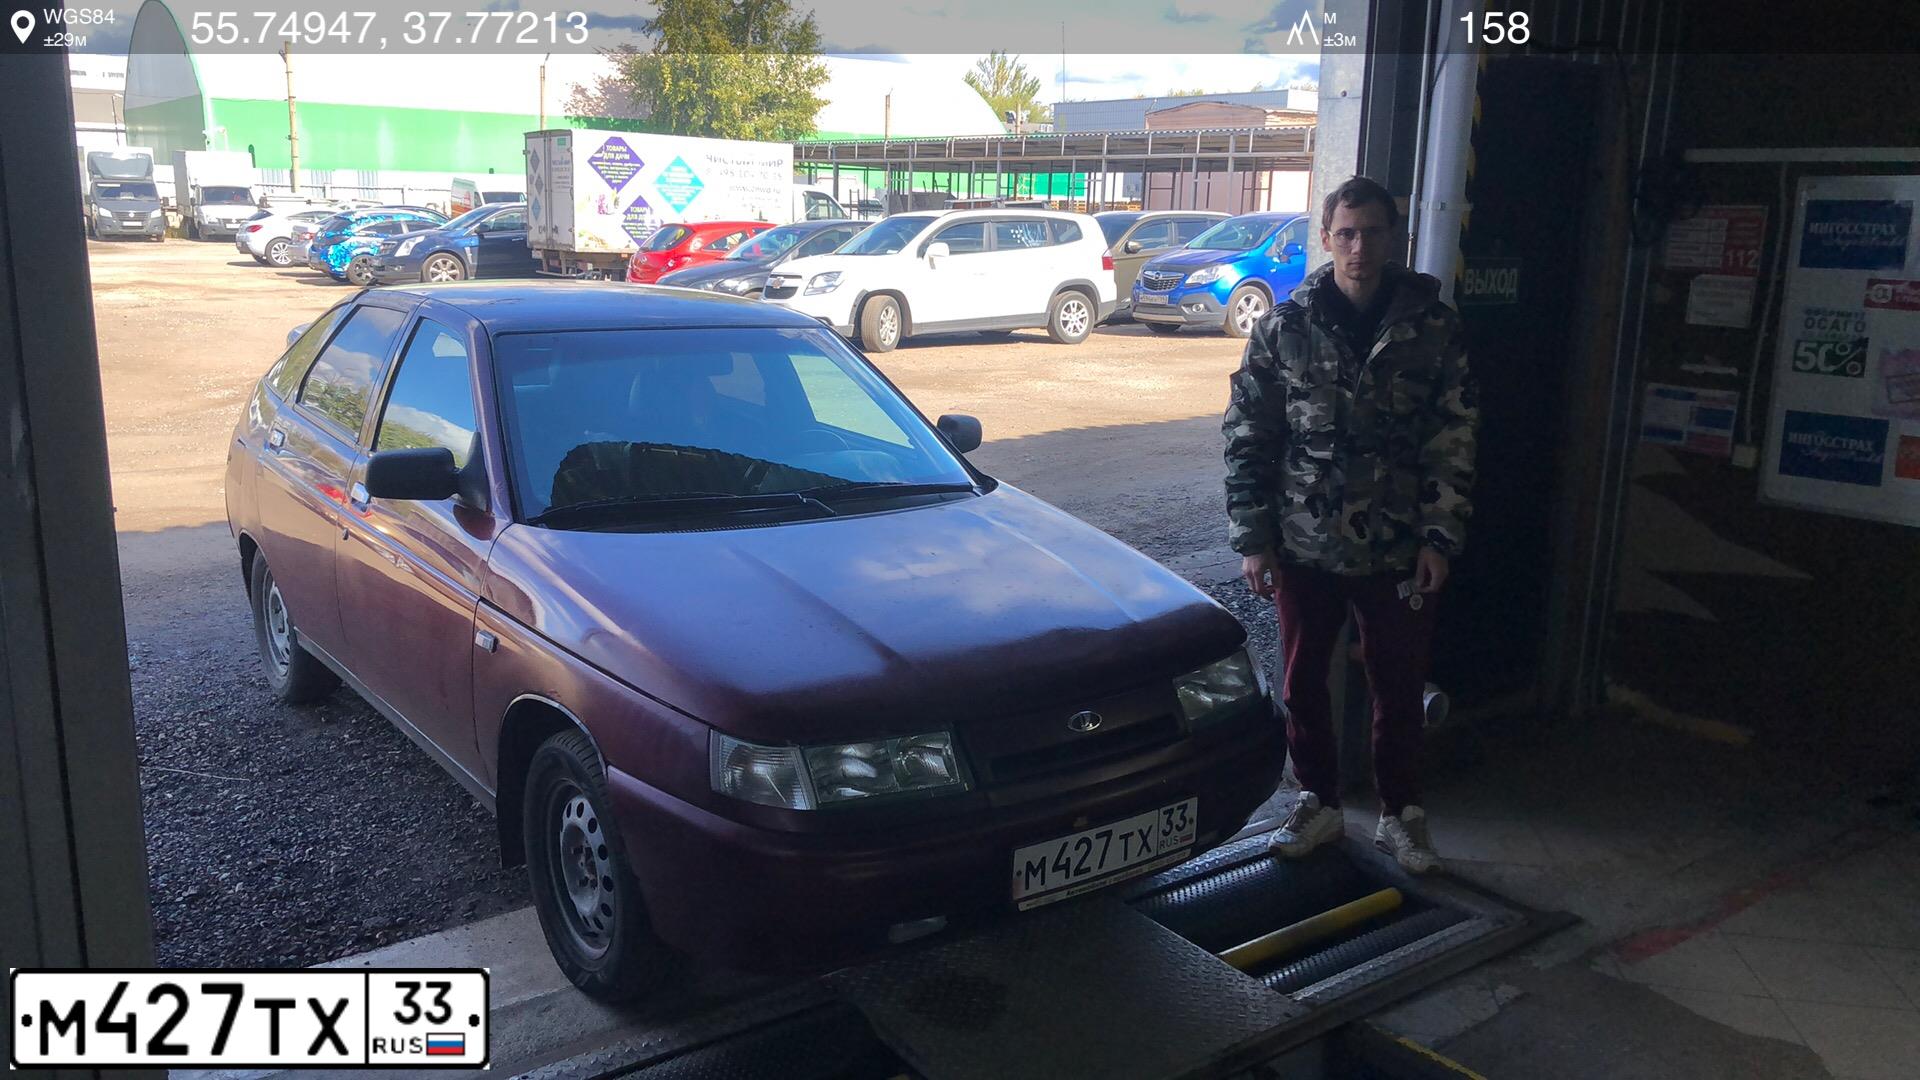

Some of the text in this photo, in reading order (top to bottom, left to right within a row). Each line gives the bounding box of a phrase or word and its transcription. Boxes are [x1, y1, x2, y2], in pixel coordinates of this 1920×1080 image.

[1808, 221, 1897, 237] ИНГОССТРАХ
[1726, 249, 1760, 269] 112
[1463, 268, 1518, 298] ВЫХОД
[1804, 316, 1866, 333] ОСАГО
[1788, 430, 1874, 453] ИНГОССТРАХ
[1161, 803, 1188, 837] 33
[1159, 836, 1179, 850] RUS
[1025, 824, 1153, 890] М427ТХ
